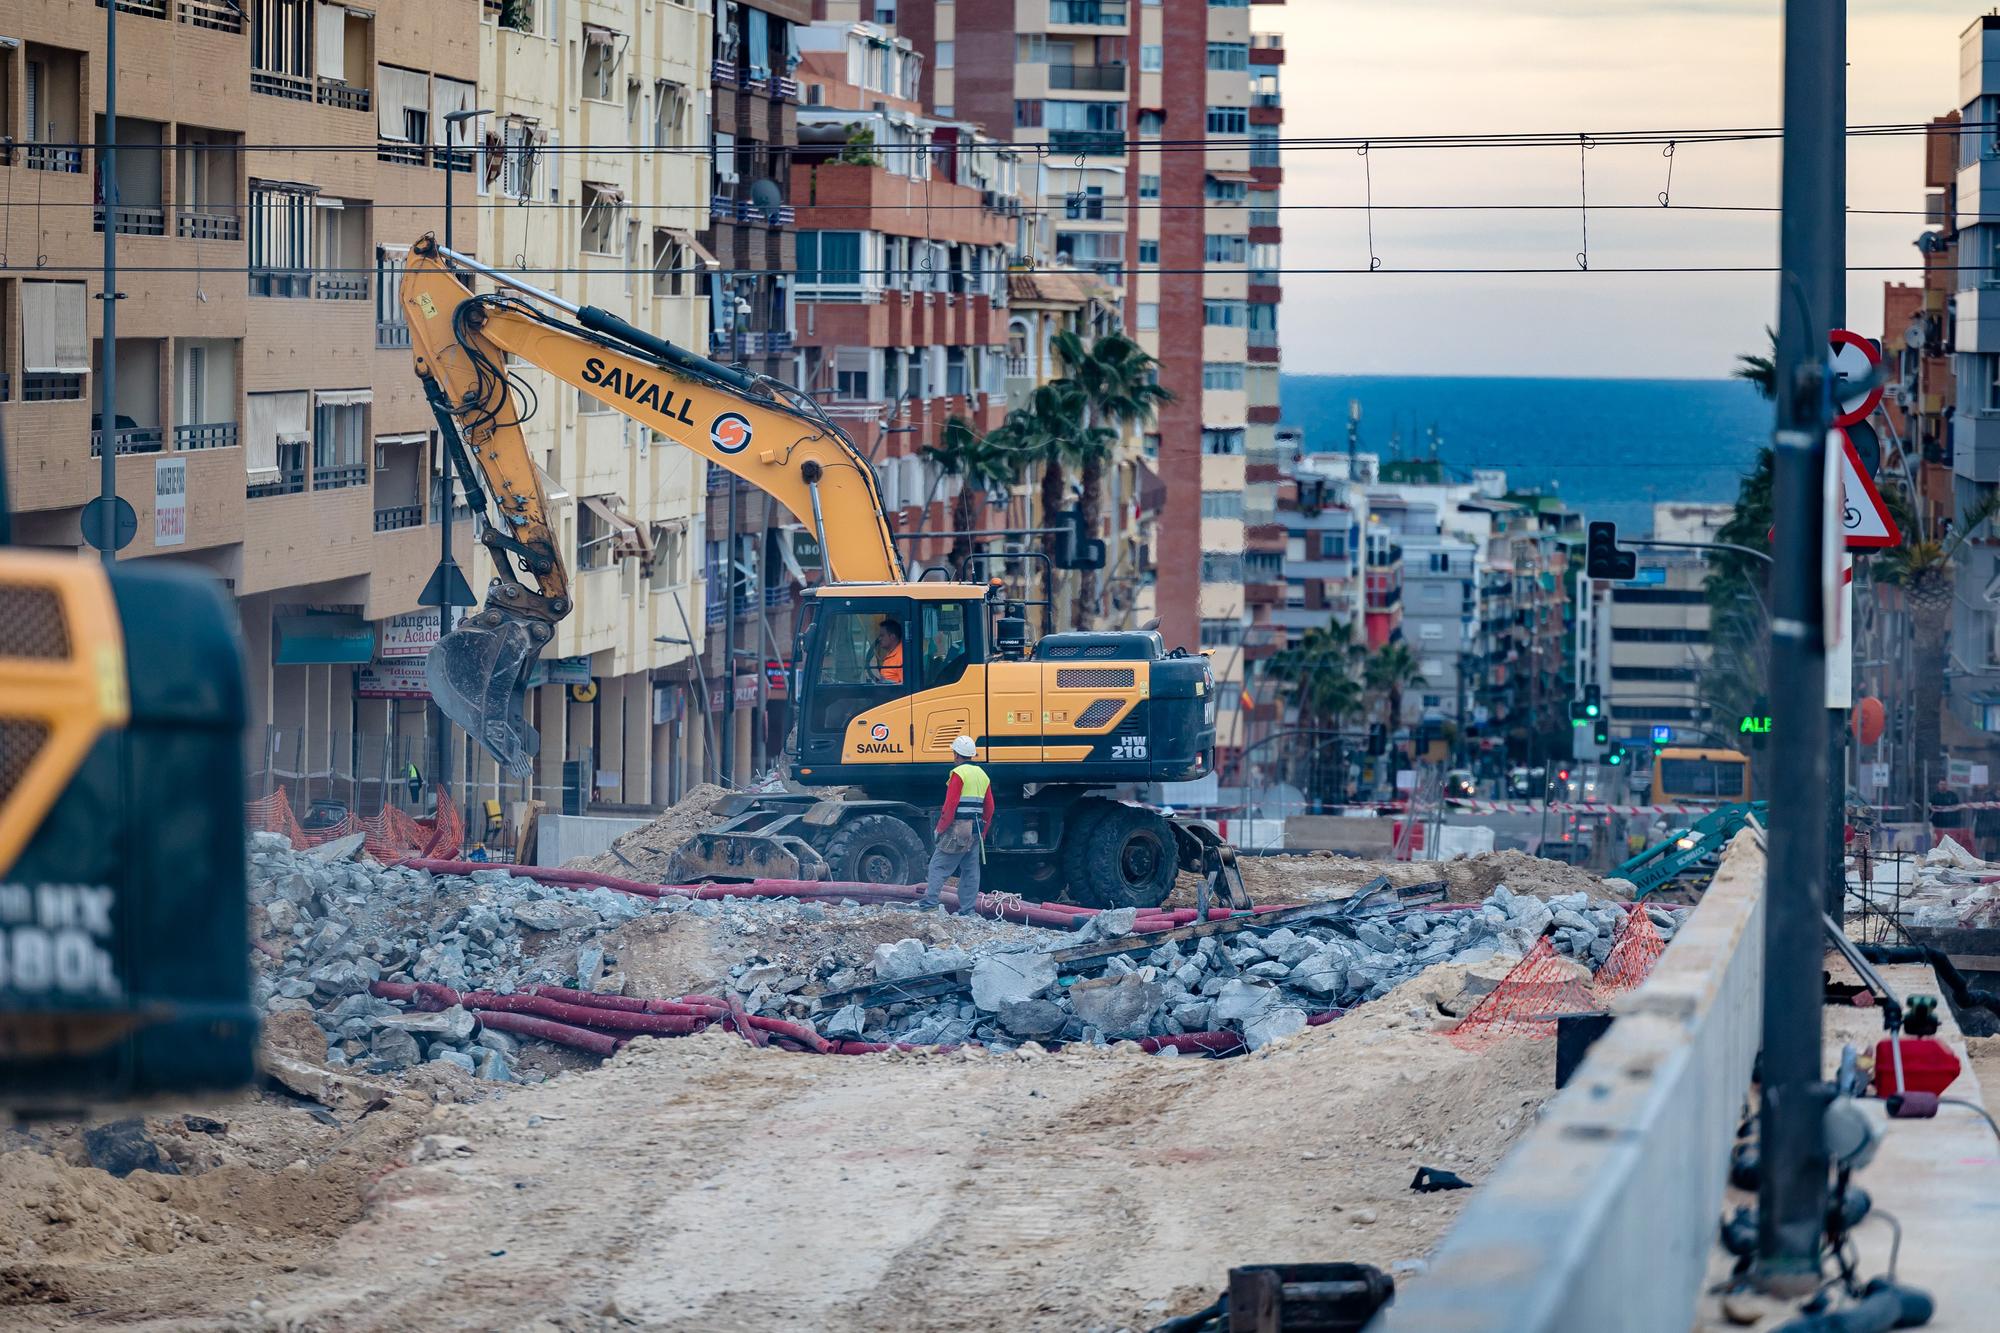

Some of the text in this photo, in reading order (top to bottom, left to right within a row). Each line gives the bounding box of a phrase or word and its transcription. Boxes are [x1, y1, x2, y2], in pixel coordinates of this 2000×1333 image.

[581, 357, 694, 427] SAVALL
[797, 544, 820, 555] ABO
[391, 615, 455, 631] Languae
[403, 628, 441, 643] Acade
[1121, 736, 1147, 746] HW
[857, 743, 904, 754] SAVALL
[1111, 745, 1147, 759] 210
[1637, 867, 1672, 890] AVALL
